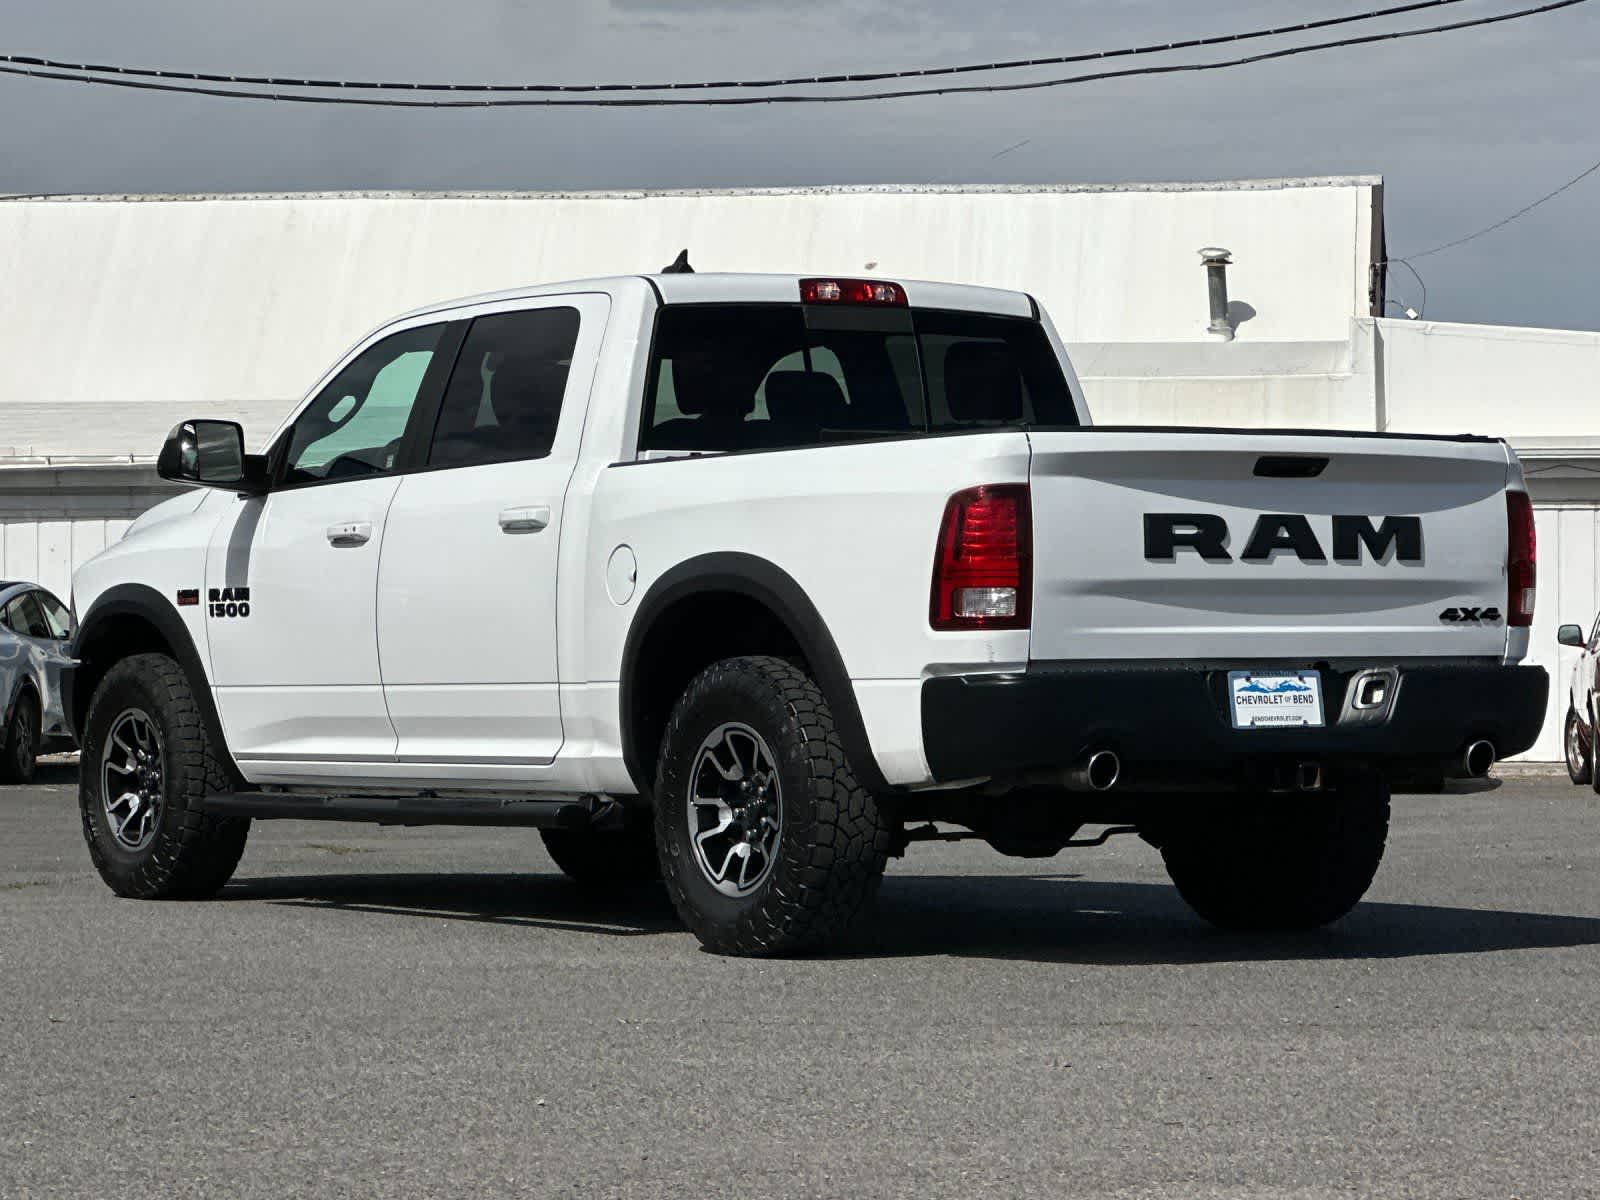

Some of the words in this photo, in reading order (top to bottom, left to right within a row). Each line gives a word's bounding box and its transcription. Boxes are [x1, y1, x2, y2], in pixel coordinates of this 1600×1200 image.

[1143, 513, 1422, 562] RAM
[208, 587, 250, 602] RAM
[208, 602, 250, 618] 1500
[1439, 607, 1501, 623] 4X4
[1236, 694, 1283, 704] CHEVROLET
[1293, 694, 1314, 704] BEND
